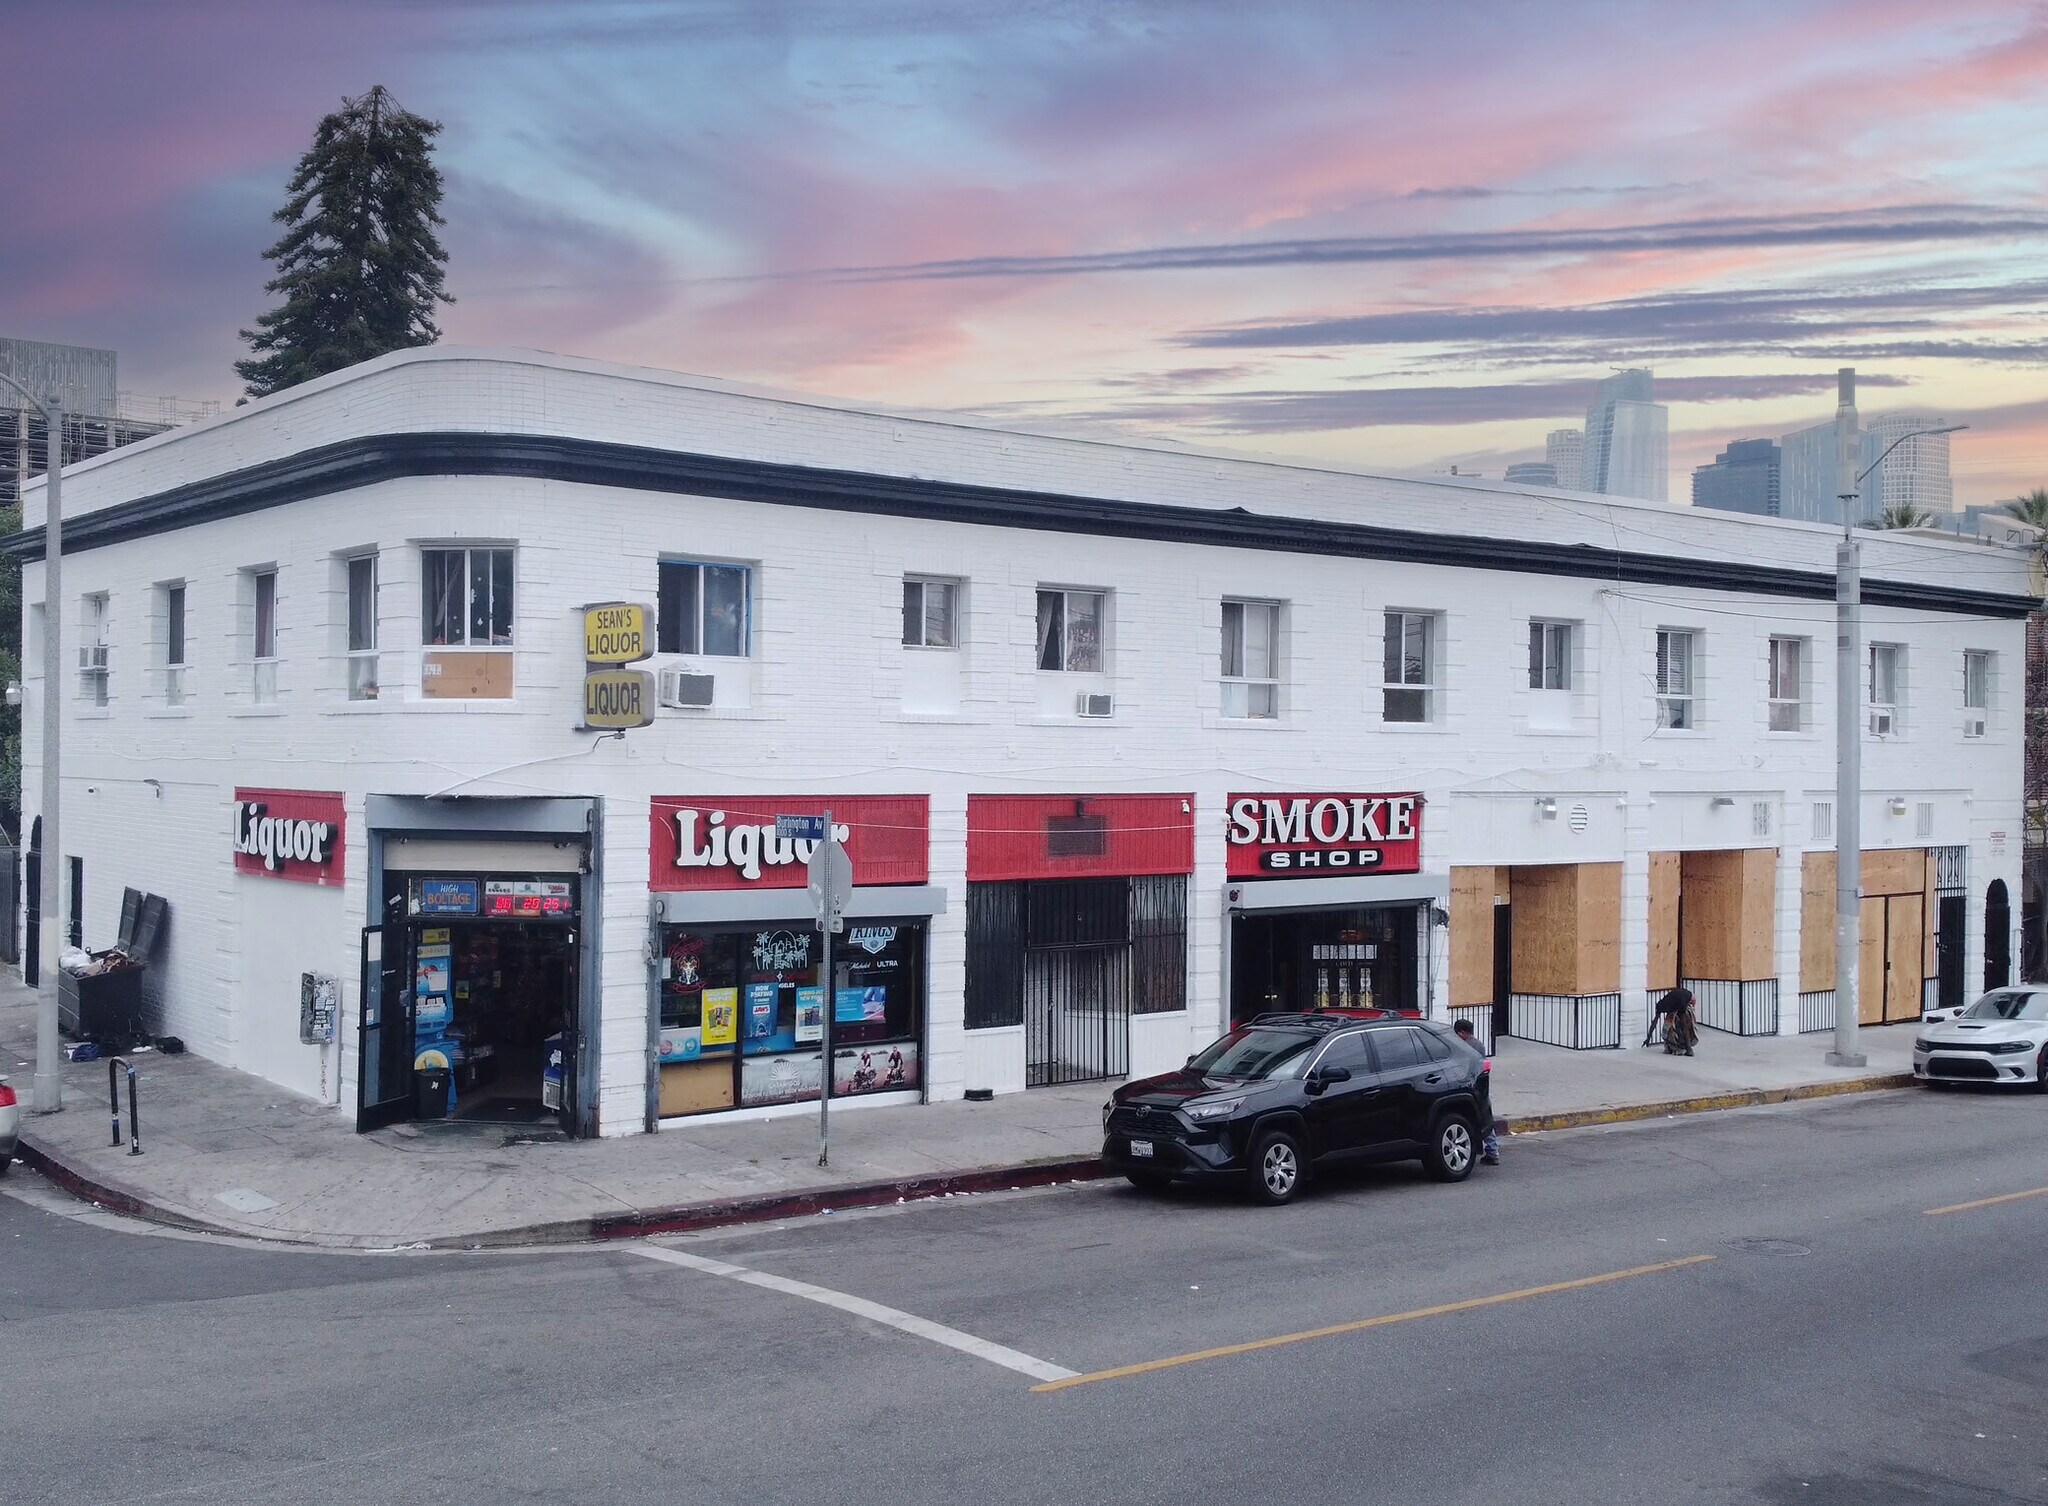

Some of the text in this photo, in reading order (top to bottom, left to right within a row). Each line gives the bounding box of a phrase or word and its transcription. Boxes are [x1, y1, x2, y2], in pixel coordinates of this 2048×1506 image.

[597, 609, 632, 629] SEAN'S
[586, 632, 641, 655] LIQUOR
[586, 682, 641, 716] LIQUOR
[776, 816, 823, 833] Burlington Av
[1231, 797, 1416, 845] SMOKE
[234, 800, 328, 871] Liquor
[1270, 850, 1379, 868] SHOP
[440, 884, 460, 893] HIGH
[876, 960, 898, 968] ULTRA
